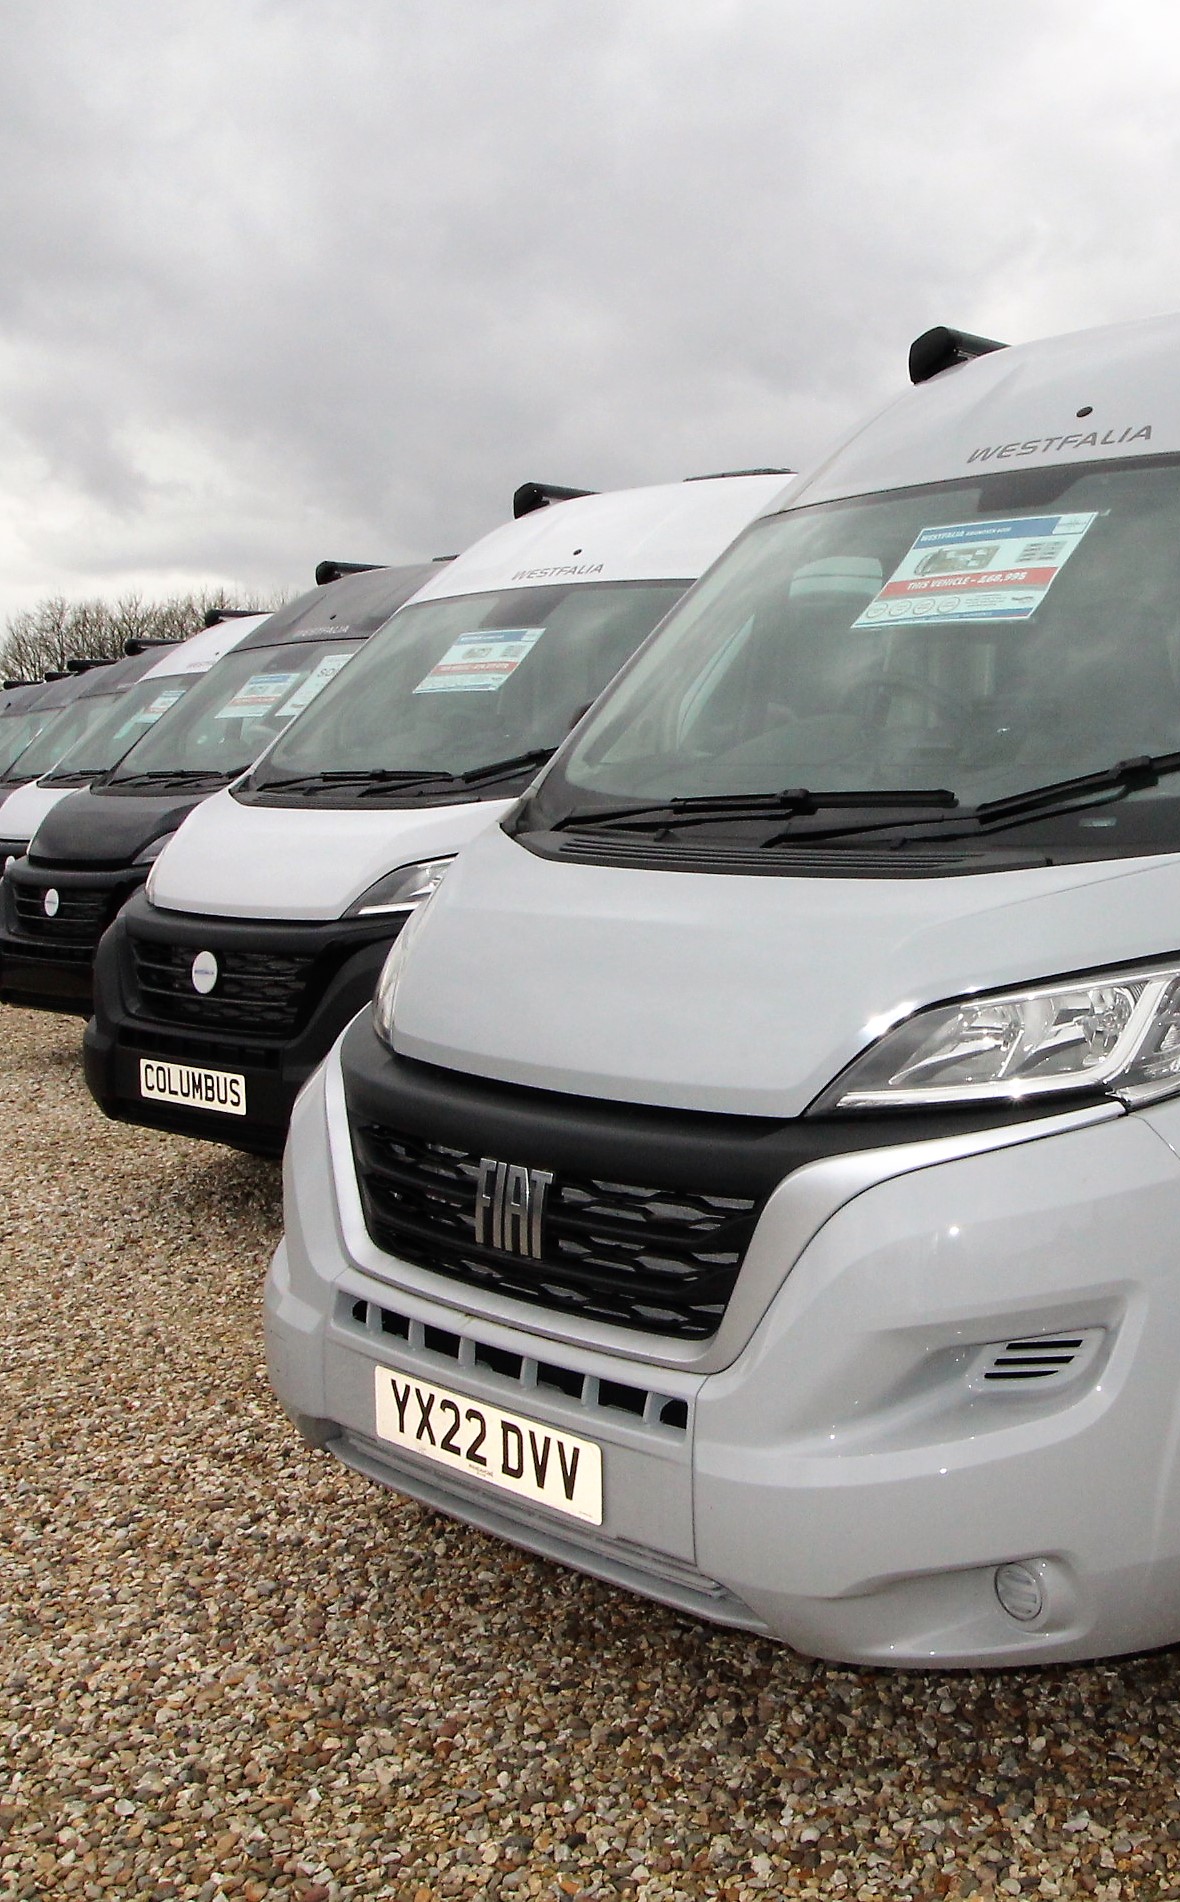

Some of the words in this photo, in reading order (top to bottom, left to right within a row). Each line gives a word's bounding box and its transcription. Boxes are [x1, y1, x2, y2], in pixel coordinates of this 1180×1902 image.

[966, 424, 1153, 464] WESTFALIA
[511, 563, 605, 581] WESTFALIA
[906, 580, 929, 590] THIS
[930, 577, 970, 588] VEHICLE
[144, 1063, 241, 1107] COLUMBUS
[475, 1157, 554, 1260] FIAT
[390, 1378, 488, 1467] YX22
[501, 1418, 580, 1501] DVV
